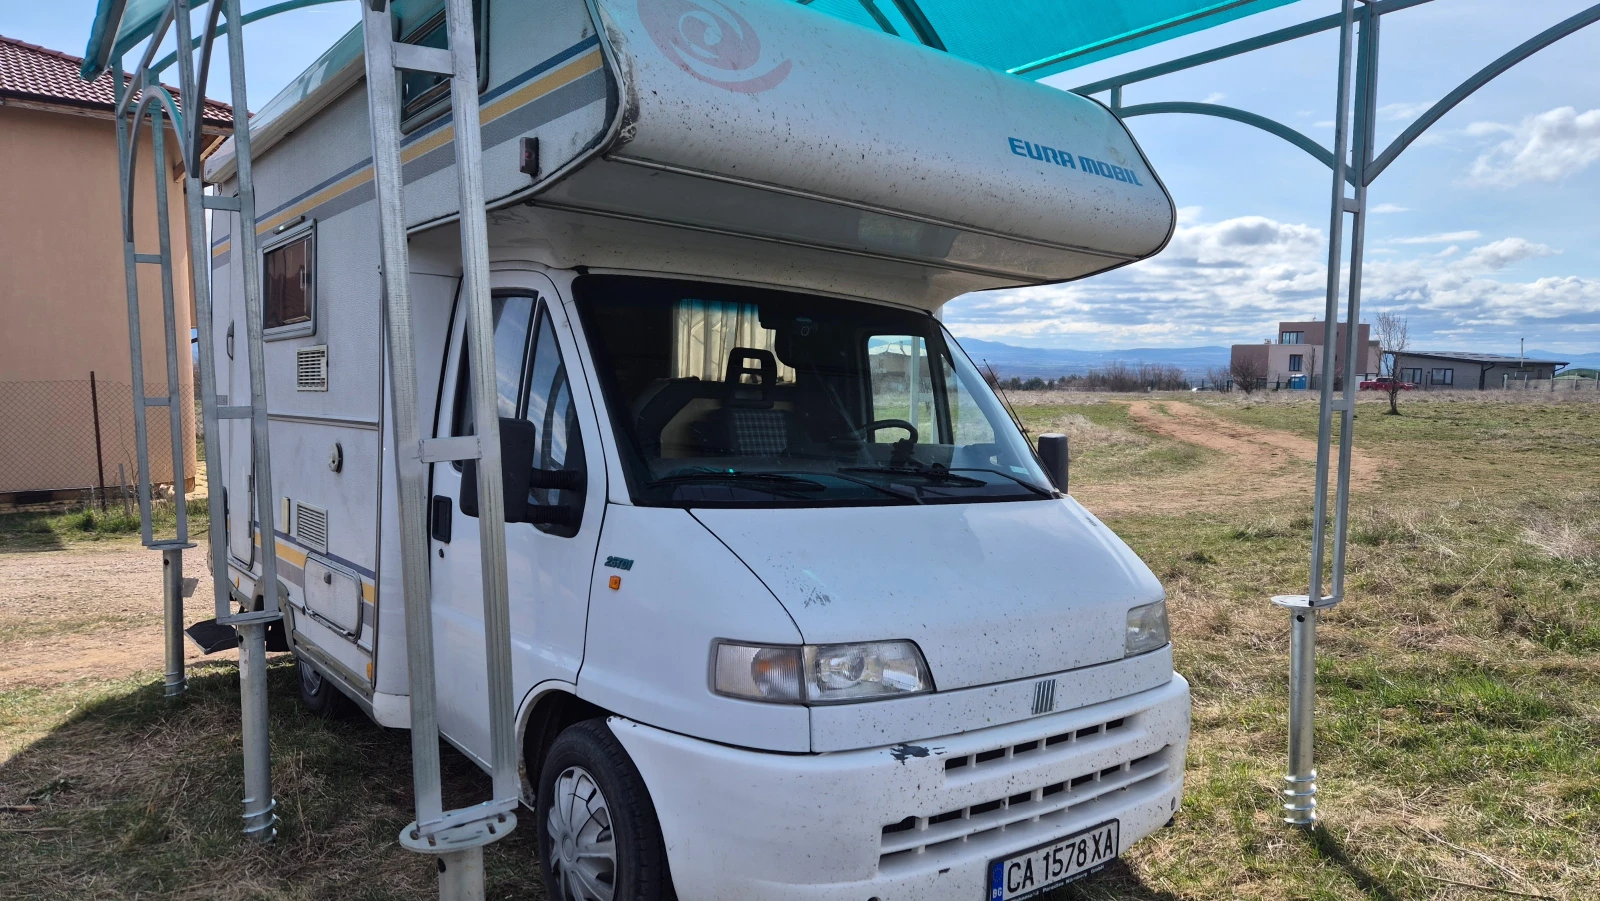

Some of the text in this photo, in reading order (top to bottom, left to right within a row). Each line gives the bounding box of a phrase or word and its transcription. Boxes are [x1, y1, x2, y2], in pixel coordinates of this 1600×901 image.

[1008, 136, 1144, 187] EURA MOBIL
[1007, 828, 1114, 893] CA 1578 XA
[992, 886, 1003, 899] BG
